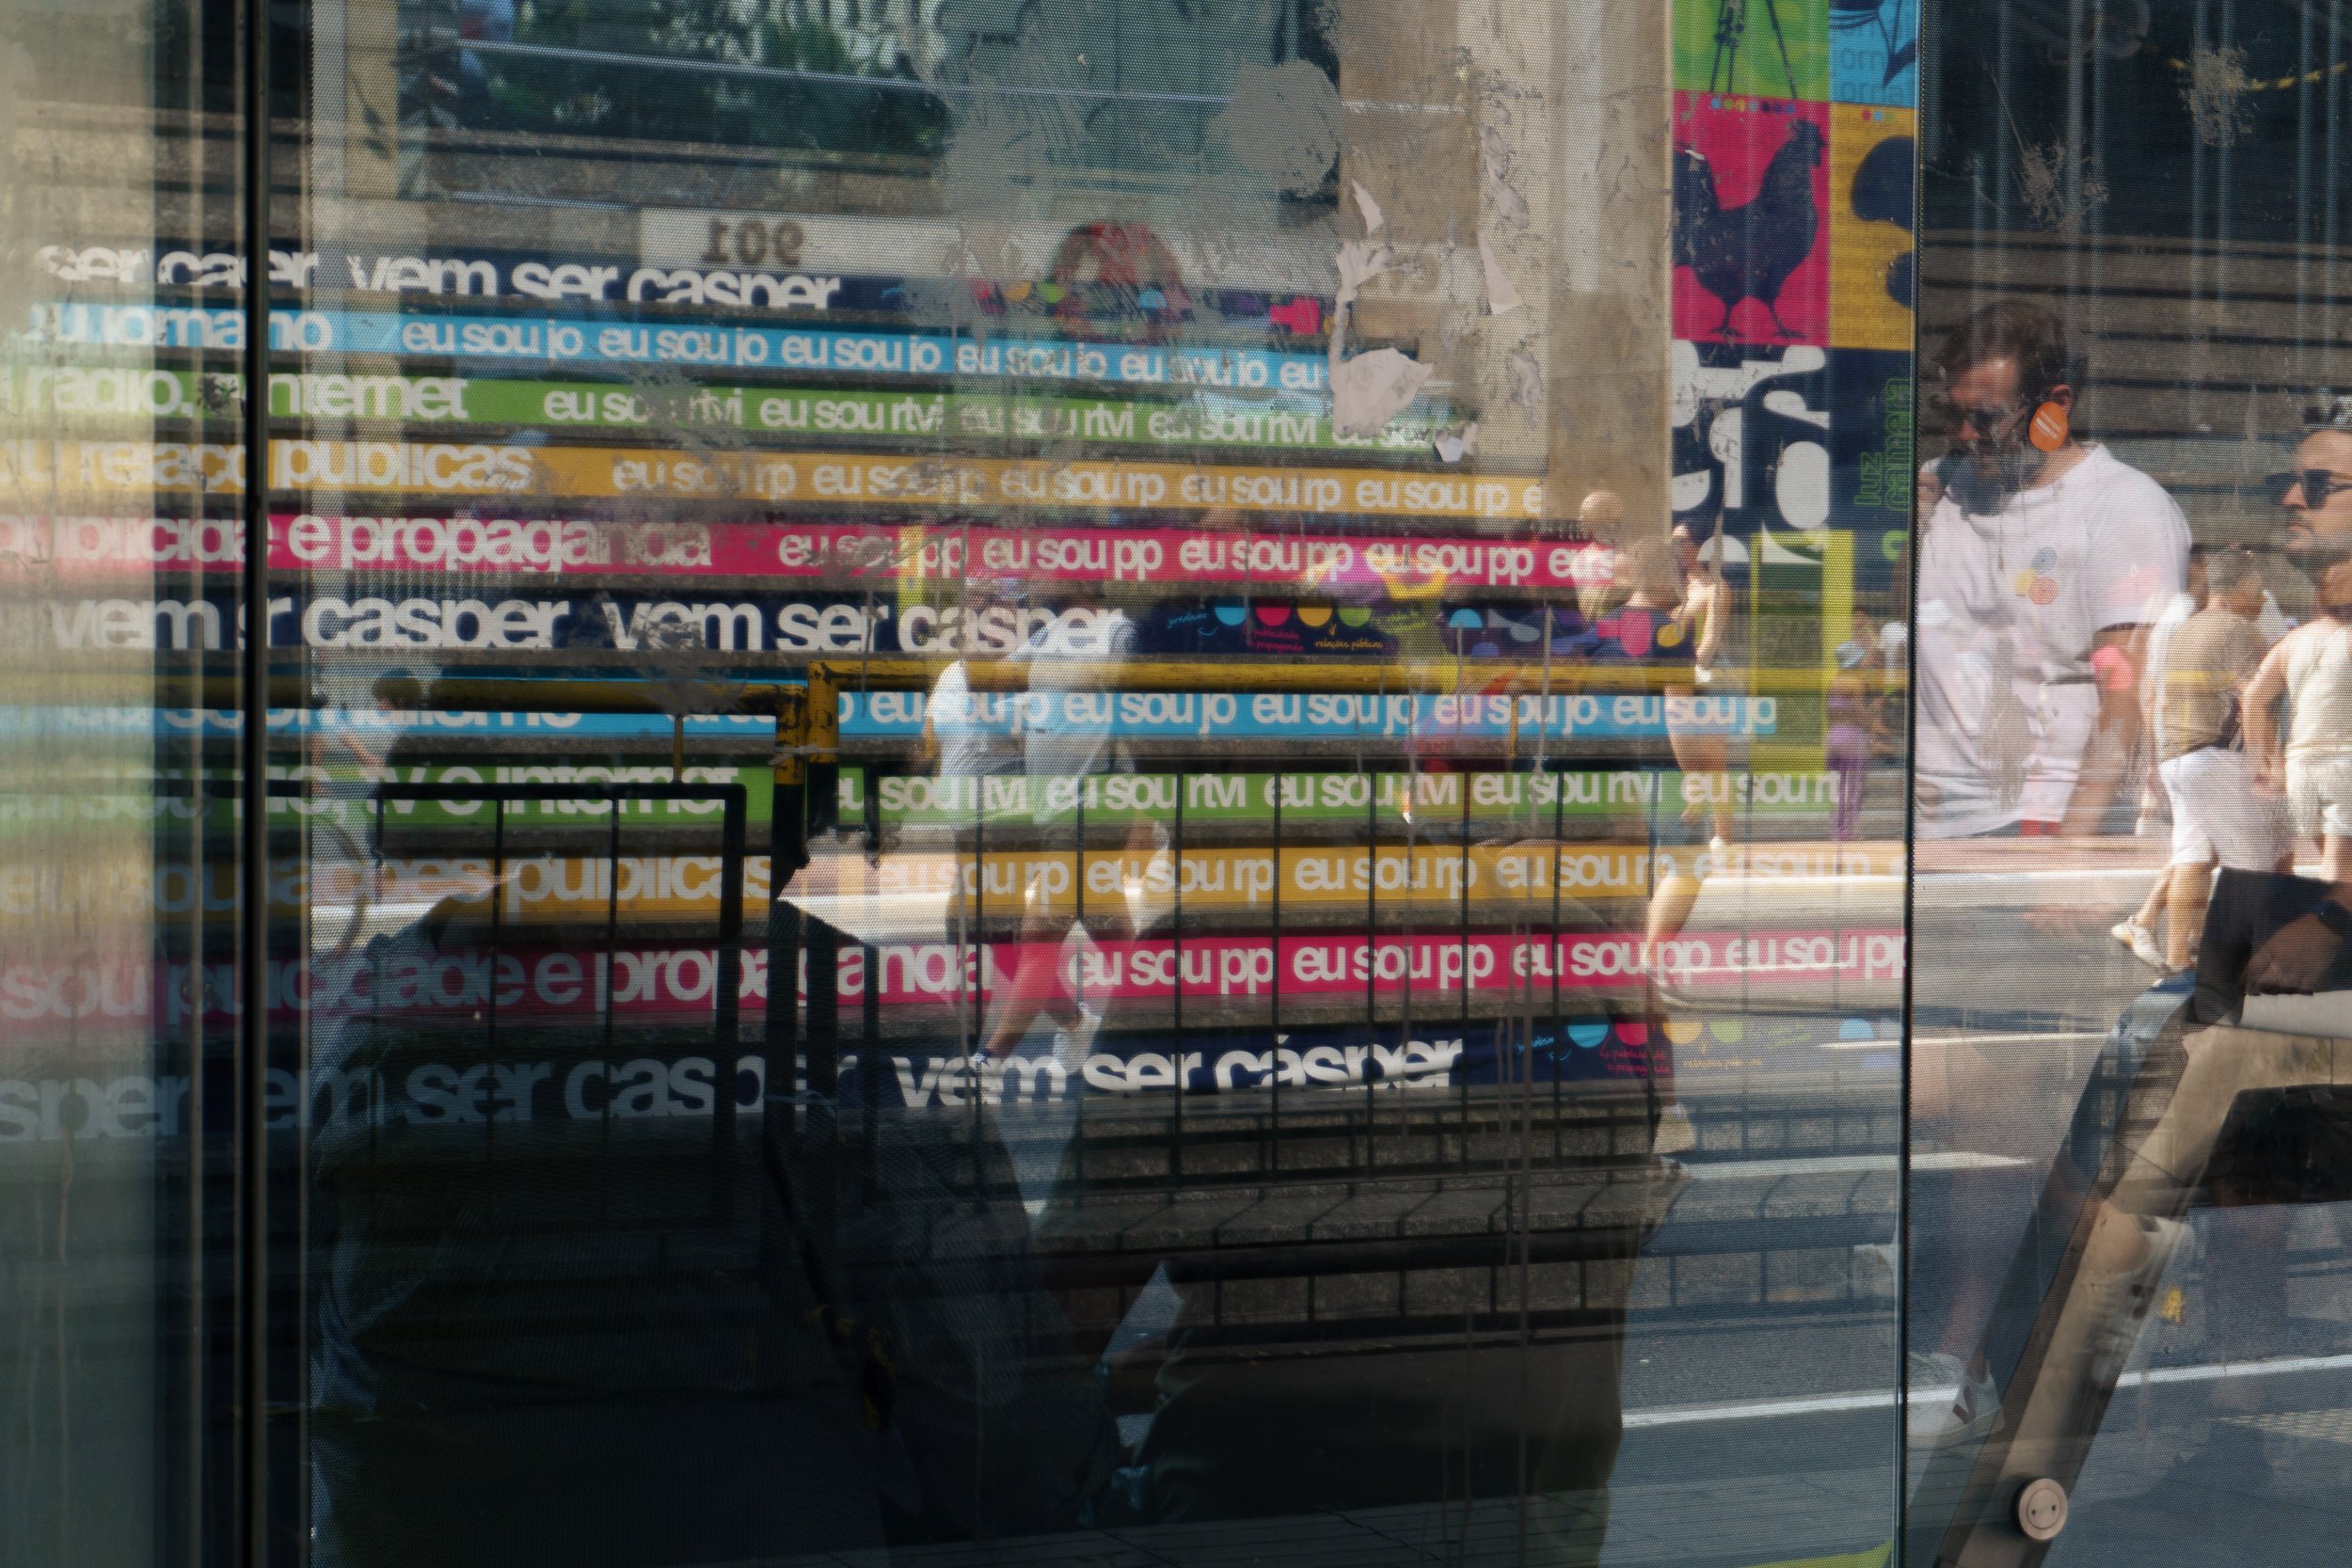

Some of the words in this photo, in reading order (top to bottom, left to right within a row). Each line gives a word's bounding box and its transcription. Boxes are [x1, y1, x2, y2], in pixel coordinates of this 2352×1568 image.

[346, 255, 497, 296] vem
[512, 261, 618, 301] ser
[403, 322, 454, 354] eu
[462, 324, 539, 356] sou
[546, 318, 583, 359] jo
[598, 325, 648, 358] eu
[656, 329, 727, 362] sou
[736, 326, 769, 366] jo
[782, 335, 828, 365] eu
[834, 339, 902, 369] sou
[909, 335, 941, 372] jo
[958, 344, 999, 373] eu
[1120, 351, 1163, 382] eu
[1237, 351, 1267, 388] jo
[1279, 361, 1323, 389] eu
[268, 373, 468, 421] nternet
[544, 392, 595, 420] eu
[759, 397, 807, 428] eu
[815, 400, 884, 431] sou
[1085, 404, 1135, 439] rtvi
[612, 459, 665, 492] eu
[813, 465, 860, 495] eu
[1000, 470, 1046, 499] eu
[1053, 471, 1120, 501] sou
[1127, 473, 1165, 507] rp
[1182, 474, 1224, 502] eu
[1232, 476, 1297, 505] sou
[1305, 478, 1343, 511] rp
[1356, 480, 1399, 508] eu
[1405, 481, 1468, 511] sou
[1474, 483, 1509, 515] rp
[289, 515, 329, 560] e
[983, 536, 1030, 571] eu
[1037, 537, 1106, 571] sou
[1114, 539, 1163, 581] pp
[1179, 539, 1223, 572] eu
[1232, 541, 1299, 572] sou
[1416, 544, 1483, 574] sou
[1489, 546, 1534, 586] pp
[50, 598, 222, 650] vem
[776, 603, 889, 654] ser
[1064, 692, 1114, 725] eu
[1120, 693, 1192, 725] sou
[1198, 693, 1236, 736] jo
[1252, 694, 1300, 725] eu
[1307, 694, 1377, 725] sou
[1382, 695, 1419, 736] jo
[1434, 695, 1482, 725] eu
[1486, 695, 1555, 725] sou
[1561, 696, 1597, 736] jo
[1613, 696, 1661, 725] eu
[1666, 696, 1736, 725] sou
[879, 776, 960, 811] sou
[1104, 776, 1176, 811] sou
[1263, 775, 1315, 809] eu
[1321, 774, 1395, 808] sou
[1472, 773, 1521, 807] eu
[1528, 773, 1598, 807] sou
[1679, 771, 1729, 806] eu
[1233, 856, 1273, 903] rp
[1295, 857, 1345, 889] eu
[1353, 856, 1429, 889] sou
[1436, 855, 1477, 900] rp
[1497, 855, 1546, 888] eu
[1556, 852, 1629, 887] sou
[2, 962, 149, 1020] sou
[534, 953, 583, 1006] e
[1068, 949, 1121, 987] eu
[1129, 949, 1212, 986] sou
[1219, 946, 1274, 997] pp
[1294, 945, 1345, 981] eu
[1353, 944, 1431, 980] sou
[1439, 943, 1495, 990] pp
[1513, 942, 1564, 977] eu
[1570, 941, 1645, 976] sou
[1724, 939, 1777, 973] eu
[1784, 937, 1858, 971] sou
[405, 1062, 553, 1125] ser
[892, 1054, 1066, 1108] vem
[1084, 1051, 1202, 1093] ser
